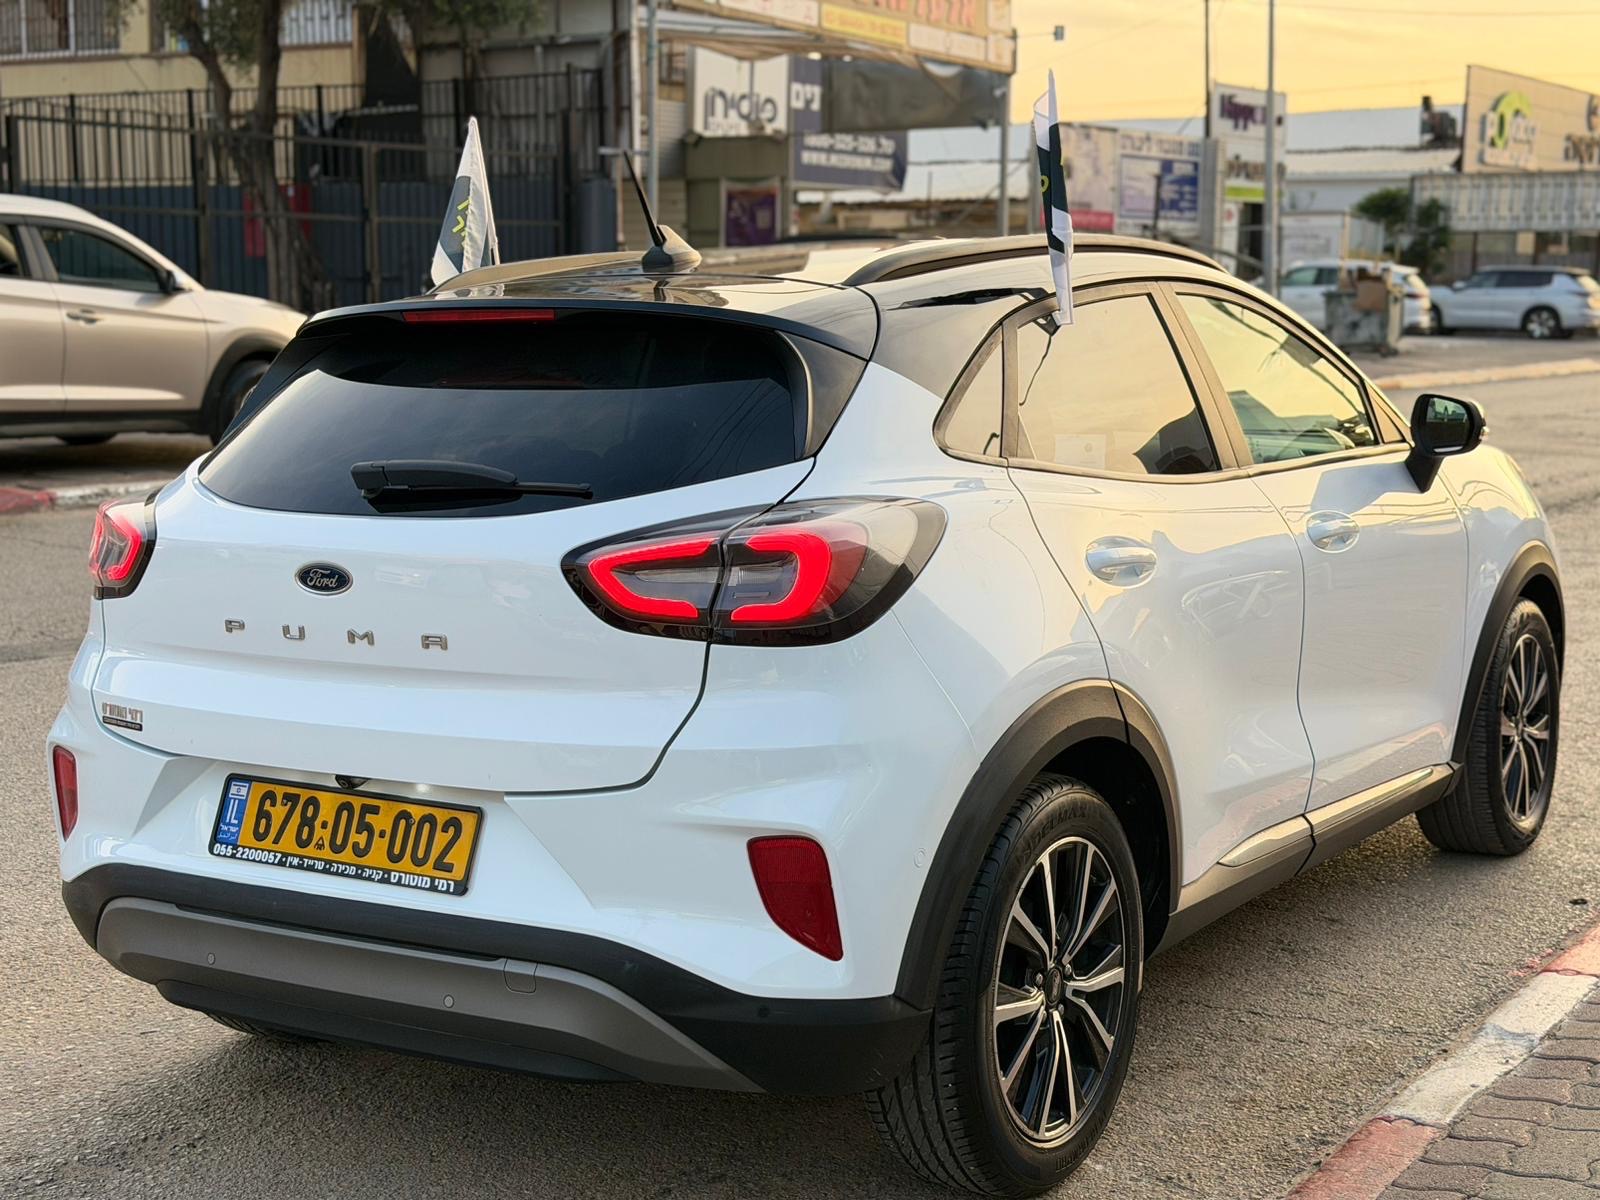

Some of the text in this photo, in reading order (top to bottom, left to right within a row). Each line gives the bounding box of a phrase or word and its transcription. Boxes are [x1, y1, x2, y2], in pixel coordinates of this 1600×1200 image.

[306, 567, 340, 588] Ford
[224, 618, 449, 651] PUMA
[225, 798, 240, 824] IL
[213, 844, 455, 892] רמי מוטורס קניה מכירה טרייד-אין 055-2200057
